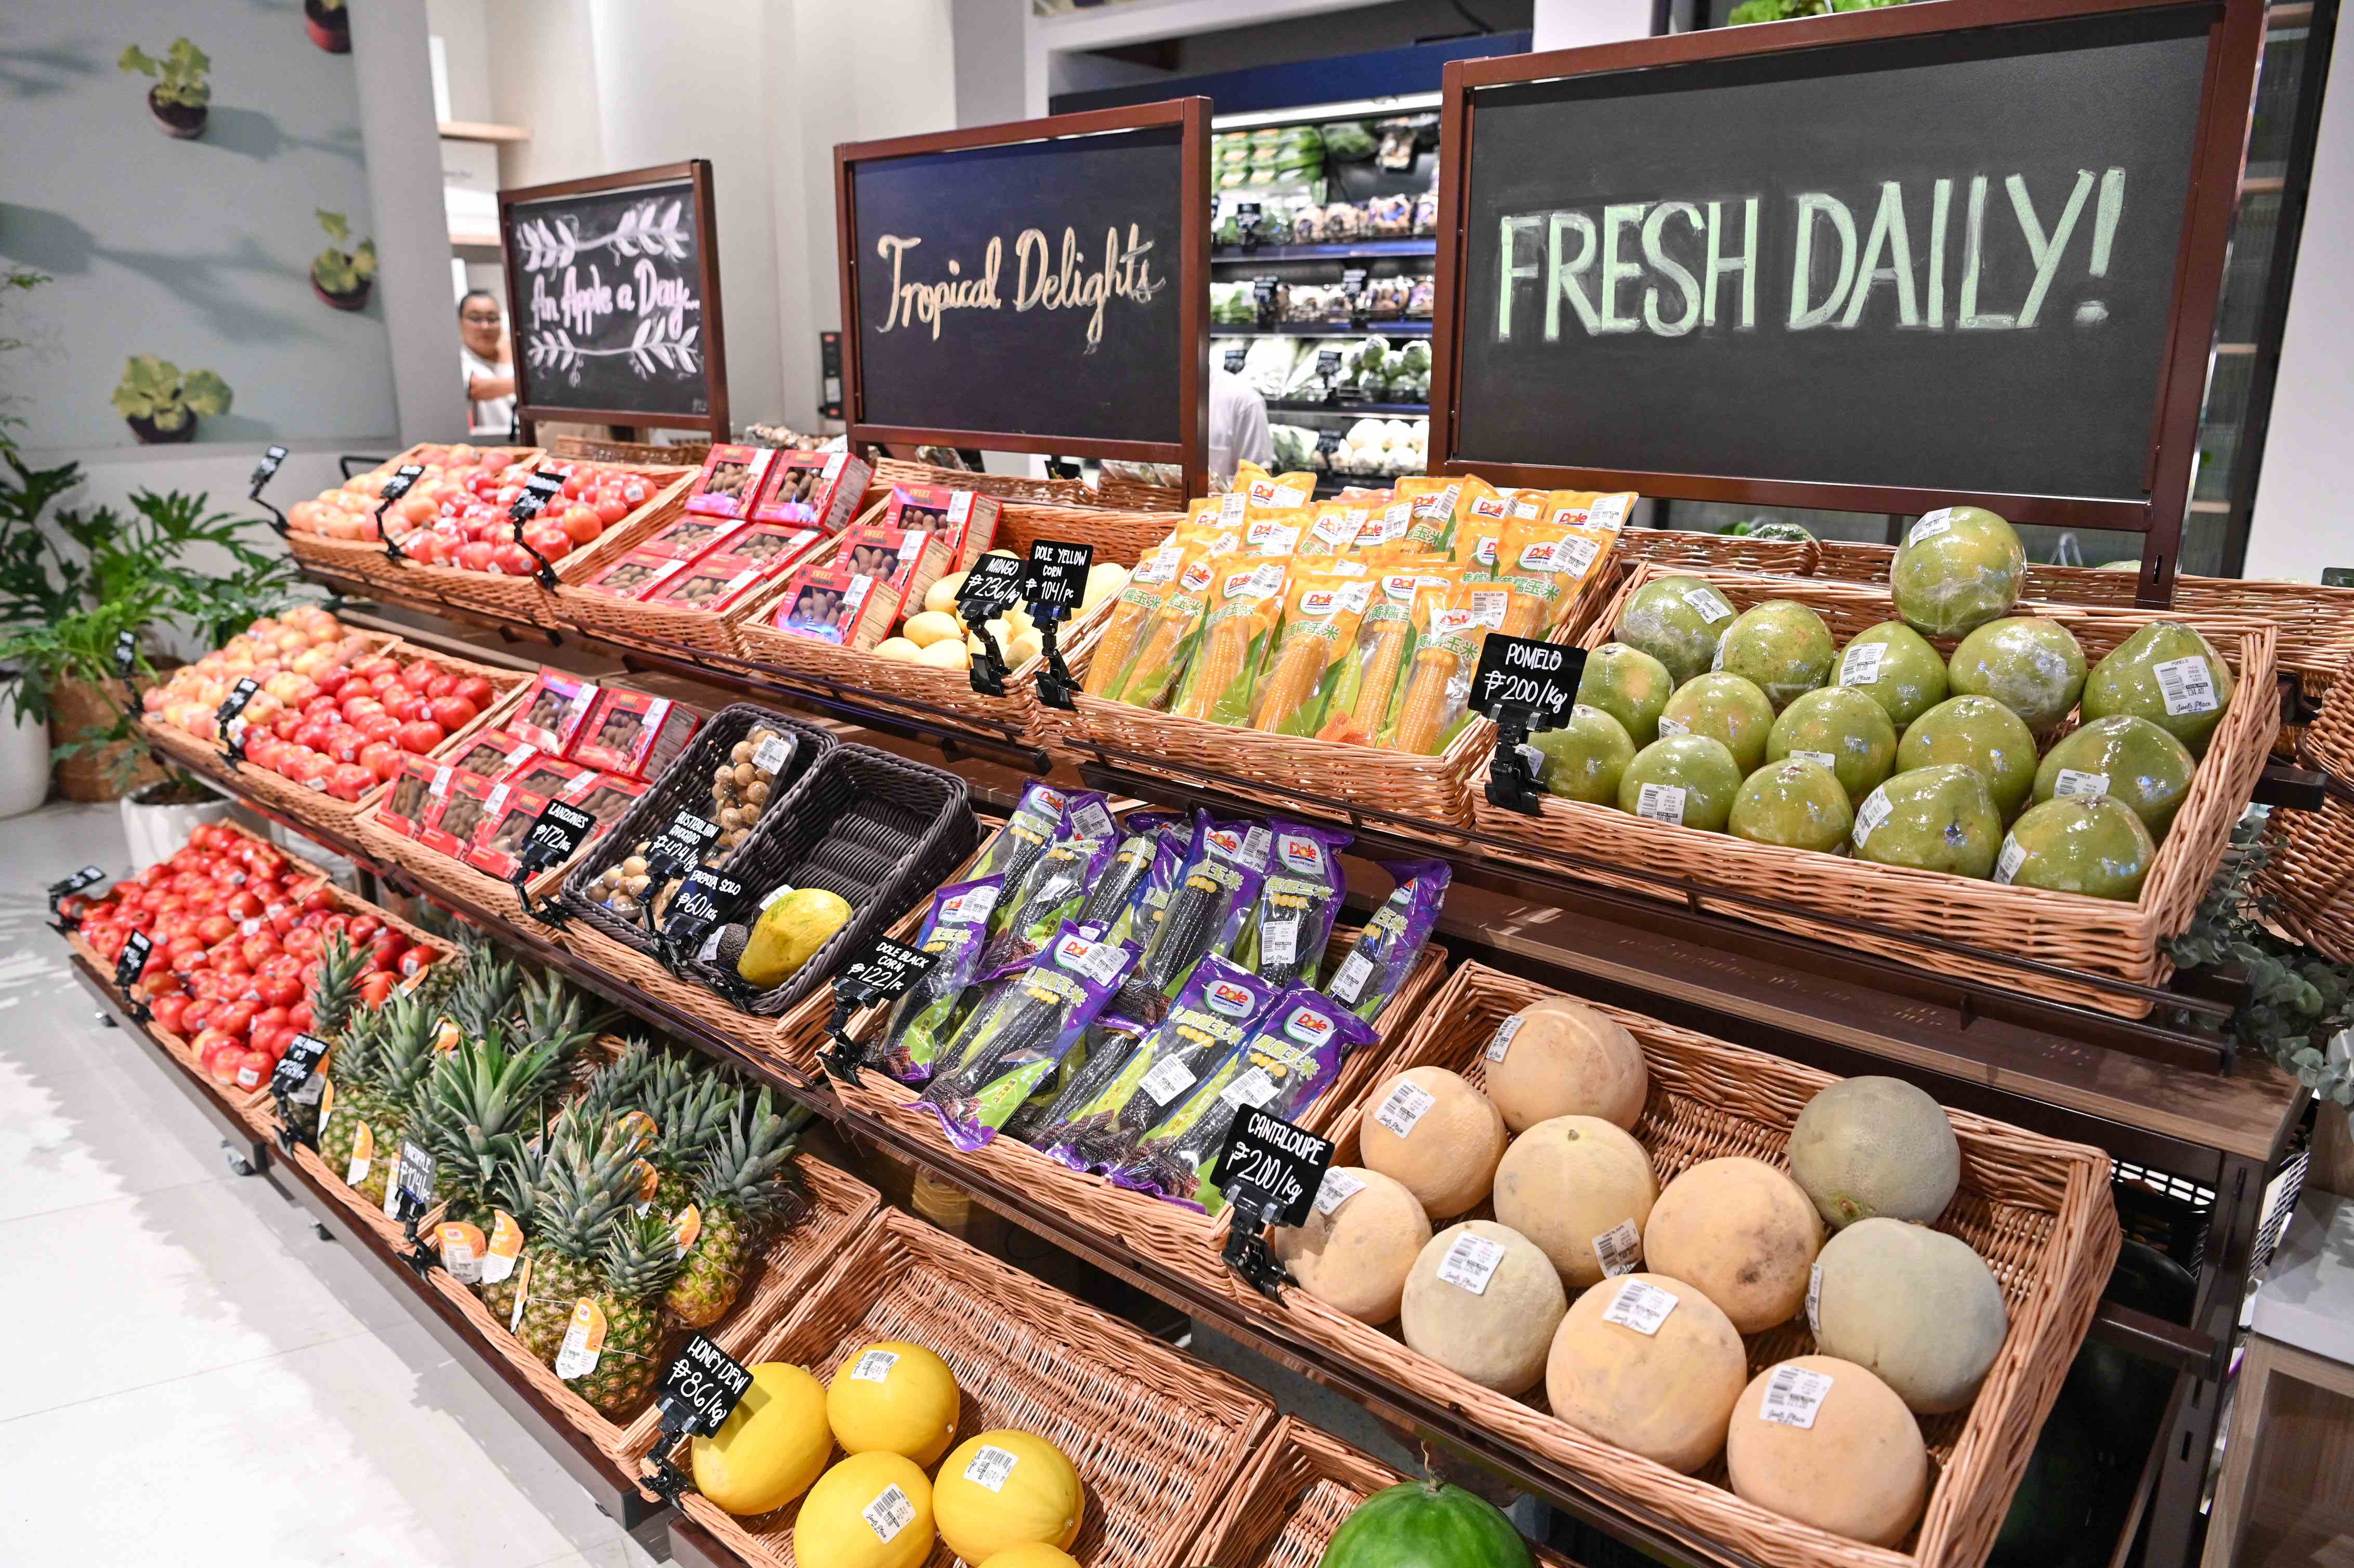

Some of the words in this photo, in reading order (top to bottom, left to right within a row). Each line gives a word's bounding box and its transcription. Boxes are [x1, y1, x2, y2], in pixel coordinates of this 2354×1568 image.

[1497, 198, 1759, 342] FRESH
[1785, 167, 2126, 330] DAILY!
[876, 234, 1001, 341] Tropical
[1013, 223, 1167, 355] Delights
[531, 274, 560, 331] An
[561, 266, 613, 335] Apple
[616, 284, 635, 311] a
[1560, 513, 1588, 525] Dole
[1035, 545, 1054, 561] DOLE
[1057, 548, 1087, 566] YELLOW
[986, 558, 1019, 576] MANGO
[1043, 565, 1063, 577] CORN
[1187, 565, 1210, 583] Dole
[1391, 578, 1416, 587] Dol
[1506, 643, 1563, 671] POMELO
[547, 803, 589, 828] LANZONES
[674, 811, 719, 838] AUSTRALIAN
[669, 825, 701, 845] AVOCADO
[1289, 841, 1317, 859] Dole
[719, 879, 741, 895] SOLO
[875, 942, 903, 957] DOLE
[898, 950, 929, 968] BLACK
[878, 956, 905, 972] CORN
[1215, 985, 1248, 1004] Dole
[1298, 1013, 1327, 1031] Dole
[1248, 1113, 1326, 1165] CANTALOUPE
[687, 1336, 726, 1374] HONEY
[718, 1363, 749, 1394] DEW
